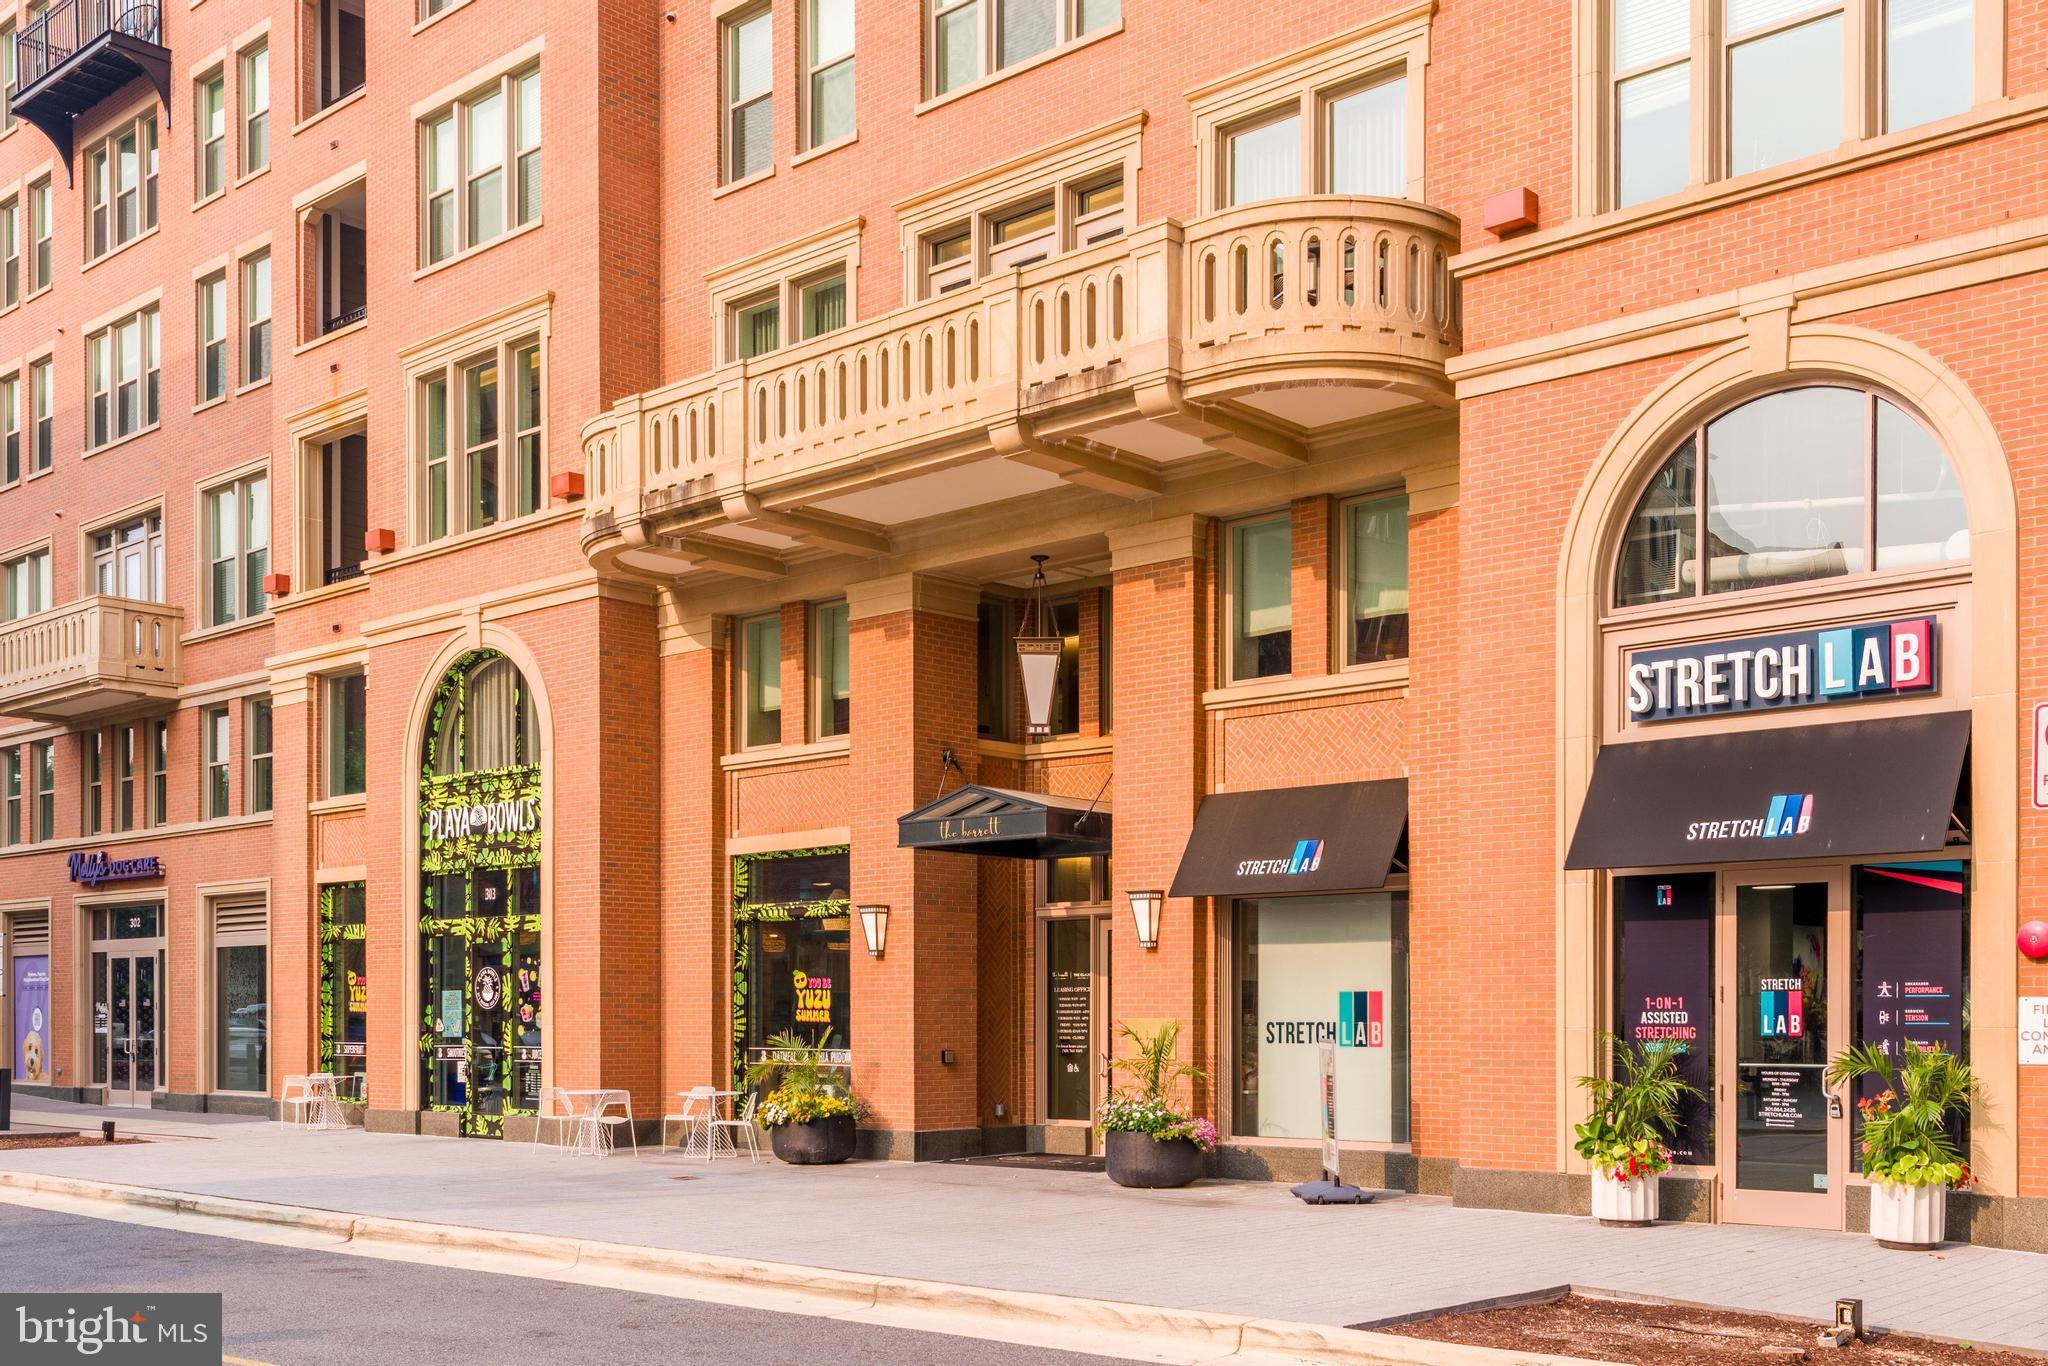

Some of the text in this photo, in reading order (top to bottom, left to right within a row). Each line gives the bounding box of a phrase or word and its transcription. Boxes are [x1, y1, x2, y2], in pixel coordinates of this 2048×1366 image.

[429, 798, 536, 840] PLAYA BOWLS
[938, 816, 1001, 839] the barrett
[68, 850, 106, 886] Molly's
[485, 888, 496, 900] 303
[129, 918, 141, 928] 302
[807, 977, 832, 989] YOU BE
[1761, 978, 1801, 990] STRETCH
[1904, 986, 1943, 994] PERFORMANCE
[796, 989, 830, 1009] YUZU
[1644, 996, 1683, 1010] 1-ON-1
[796, 1009, 830, 1022] SUMMER
[1640, 1011, 1688, 1024] ASSISTED
[1904, 1014, 1929, 1022] TENSION
[1763, 1014, 1801, 1034] LAB
[1635, 1026, 1696, 1039] STRETCHING
